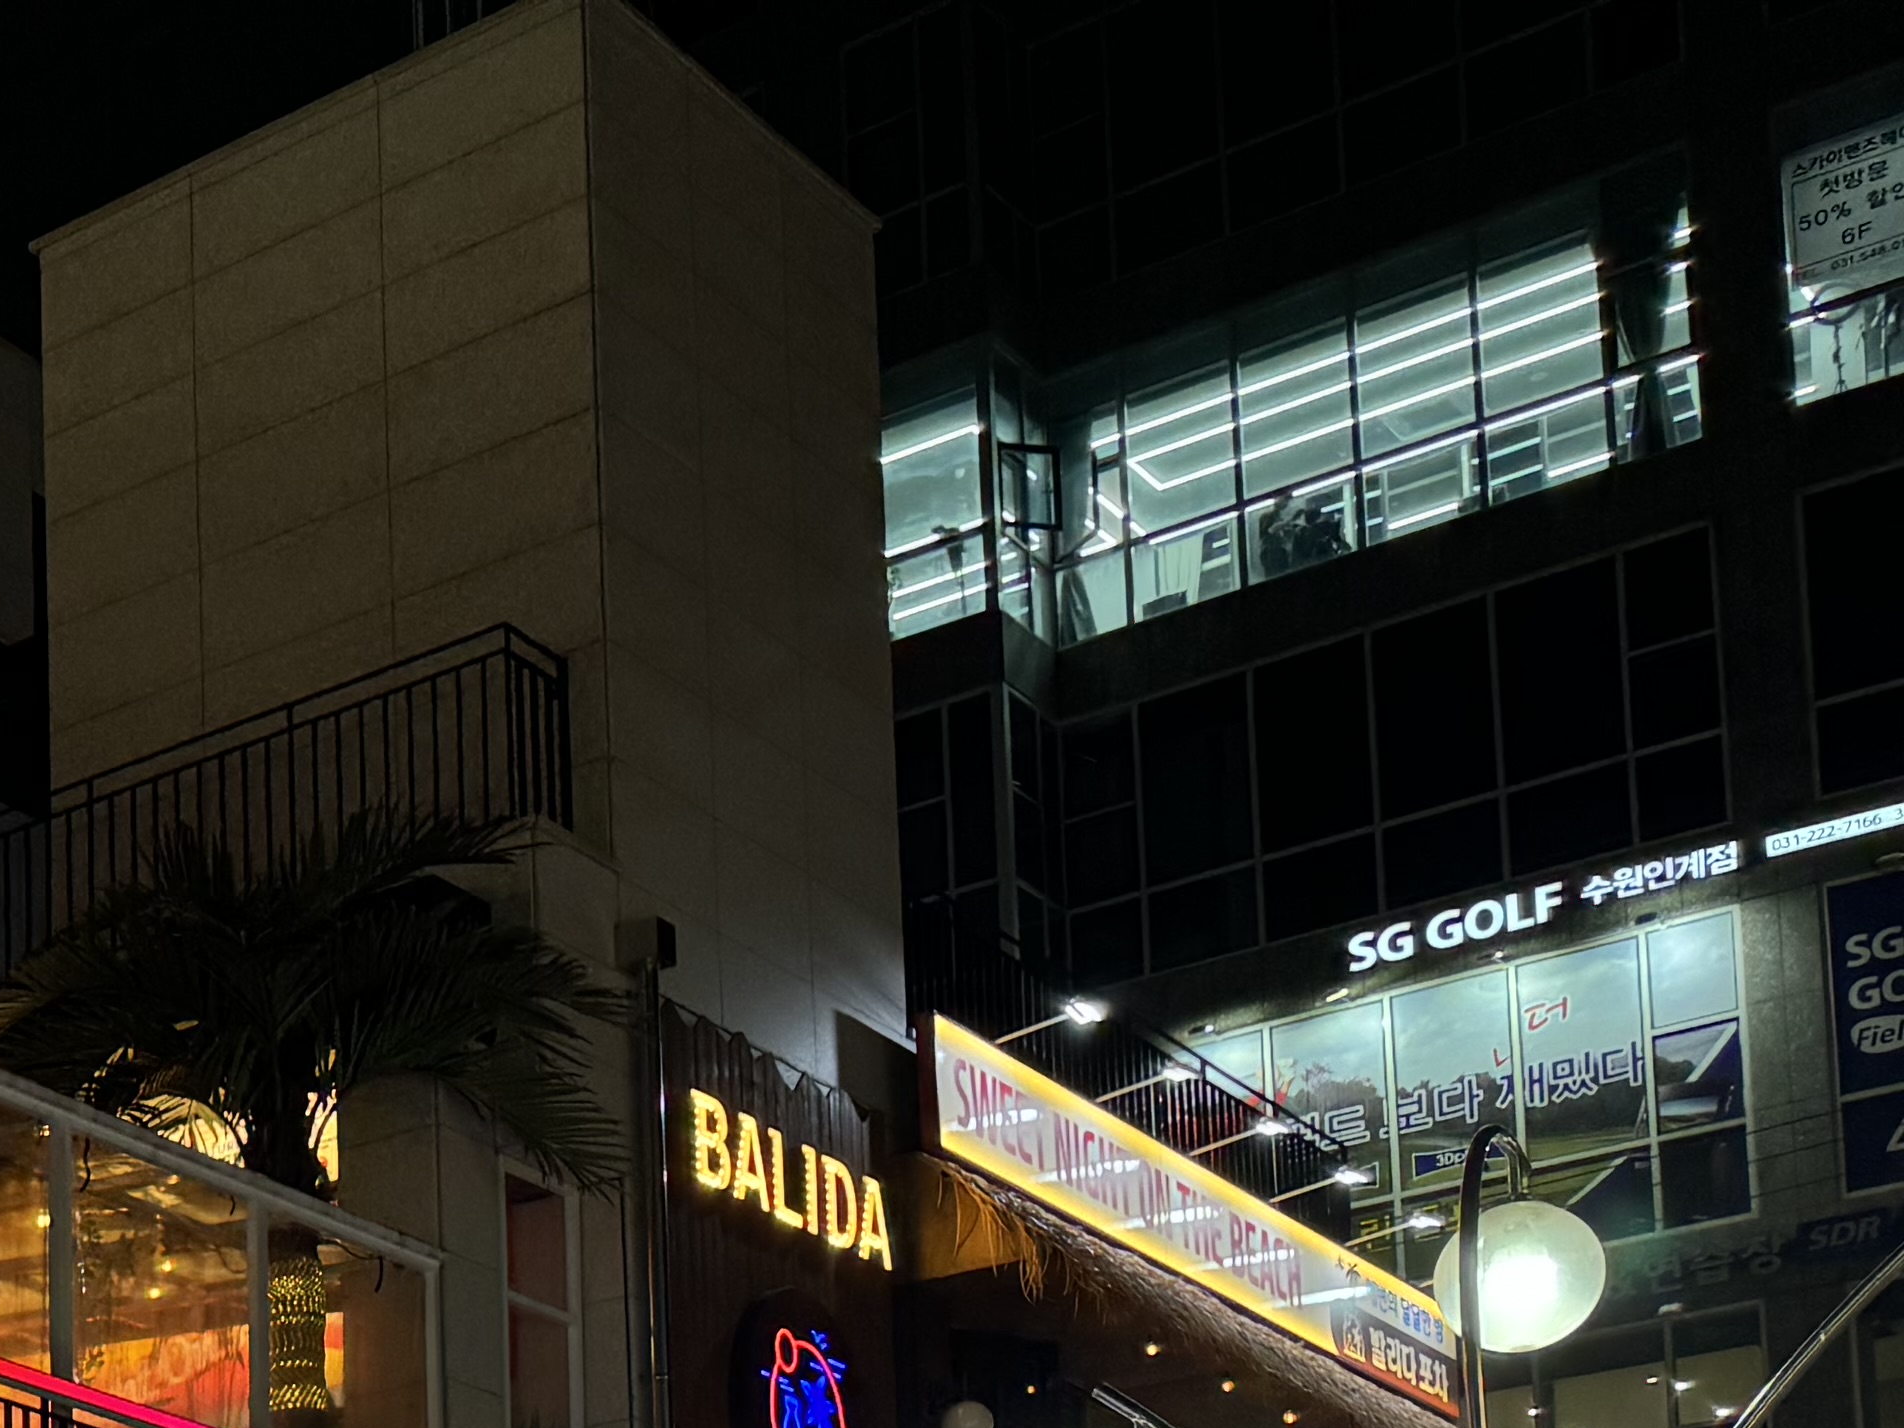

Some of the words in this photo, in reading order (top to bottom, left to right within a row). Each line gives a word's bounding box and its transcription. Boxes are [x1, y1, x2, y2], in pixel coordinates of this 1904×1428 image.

[1820, 160, 1888, 199] 첫방문
[1799, 201, 1852, 231] 50%
[1842, 221, 1872, 245] 6F
[1772, 813, 1882, 851] 031-222-7166
[1348, 921, 1415, 973] SG
[1426, 881, 1564, 950] GOLF
[1580, 841, 1738, 906] 수원인계점
[1845, 926, 1904, 968] SG
[690, 1088, 892, 1271] BALIDA
[1809, 1215, 1881, 1251] SDR
[1369, 1326, 1417, 1387] 발리다
[1419, 1351, 1449, 1404] 포차
